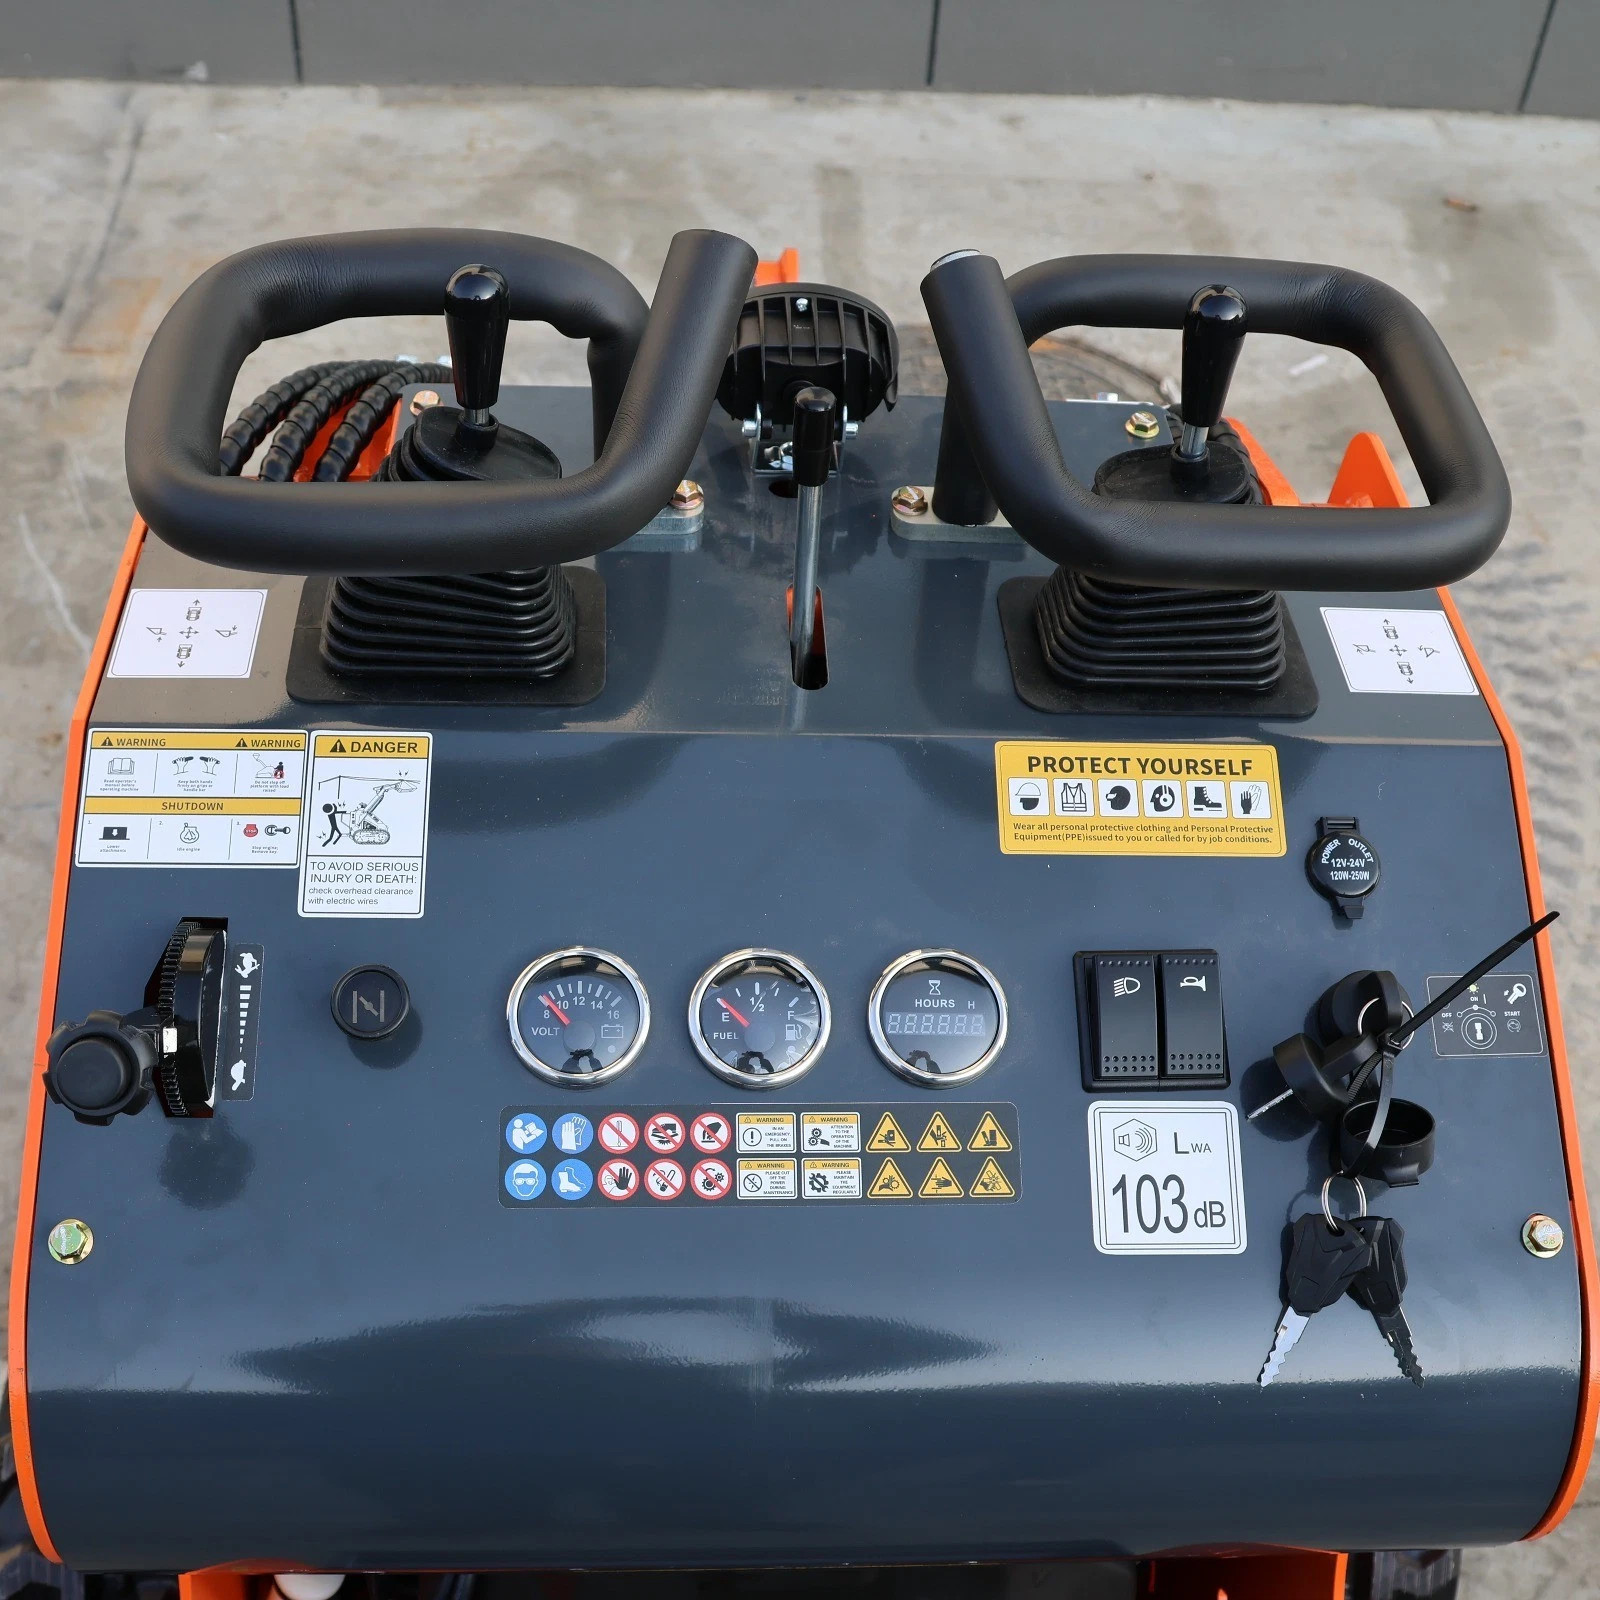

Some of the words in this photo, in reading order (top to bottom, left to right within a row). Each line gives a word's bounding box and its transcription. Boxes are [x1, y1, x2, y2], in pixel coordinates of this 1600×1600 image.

[351, 742, 418, 753] DANGER
[1028, 756, 1130, 774] PROTECT
[1137, 758, 1252, 775] YOURSELF
[1013, 822, 1034, 831] Wear
[1038, 822, 1048, 831] all
[1050, 822, 1088, 832] personal
[1090, 823, 1133, 832] protective
[1136, 823, 1171, 833] clothing
[1173, 824, 1189, 832] and
[1192, 825, 1228, 833] Personal
[1126, 835, 1141, 844] you
[1155, 834, 1177, 842] called
[1180, 834, 1195, 843] for
[1197, 834, 1206, 844] by
[1208, 835, 1222, 844] job
[1225, 835, 1272, 844] conditions.
[1322, 839, 1341, 864] POWER
[1348, 838, 1374, 863] OUTLET
[310, 862, 326, 870] TO
[328, 862, 363, 871] AVOID
[367, 862, 419, 871] SERIOUS
[1331, 859, 1365, 867] 12V-24V
[310, 874, 352, 882] INJURY
[355, 874, 372, 883] OR
[376, 875, 417, 883] DEATH:
[1330, 871, 1370, 880] 120W-250W
[557, 1001, 568, 1010] 10
[573, 997, 585, 1006] 12
[591, 1001, 603, 1010] 14
[915, 999, 955, 1008] HOURS
[968, 1001, 975, 1009] H
[544, 1010, 550, 1019] 8
[607, 1011, 620, 1019] 16
[722, 1012, 730, 1022] E
[788, 1011, 794, 1020] F
[532, 1027, 560, 1036] VOLT
[1112, 1174, 1188, 1233] 103
[1194, 1201, 1226, 1228] dB
